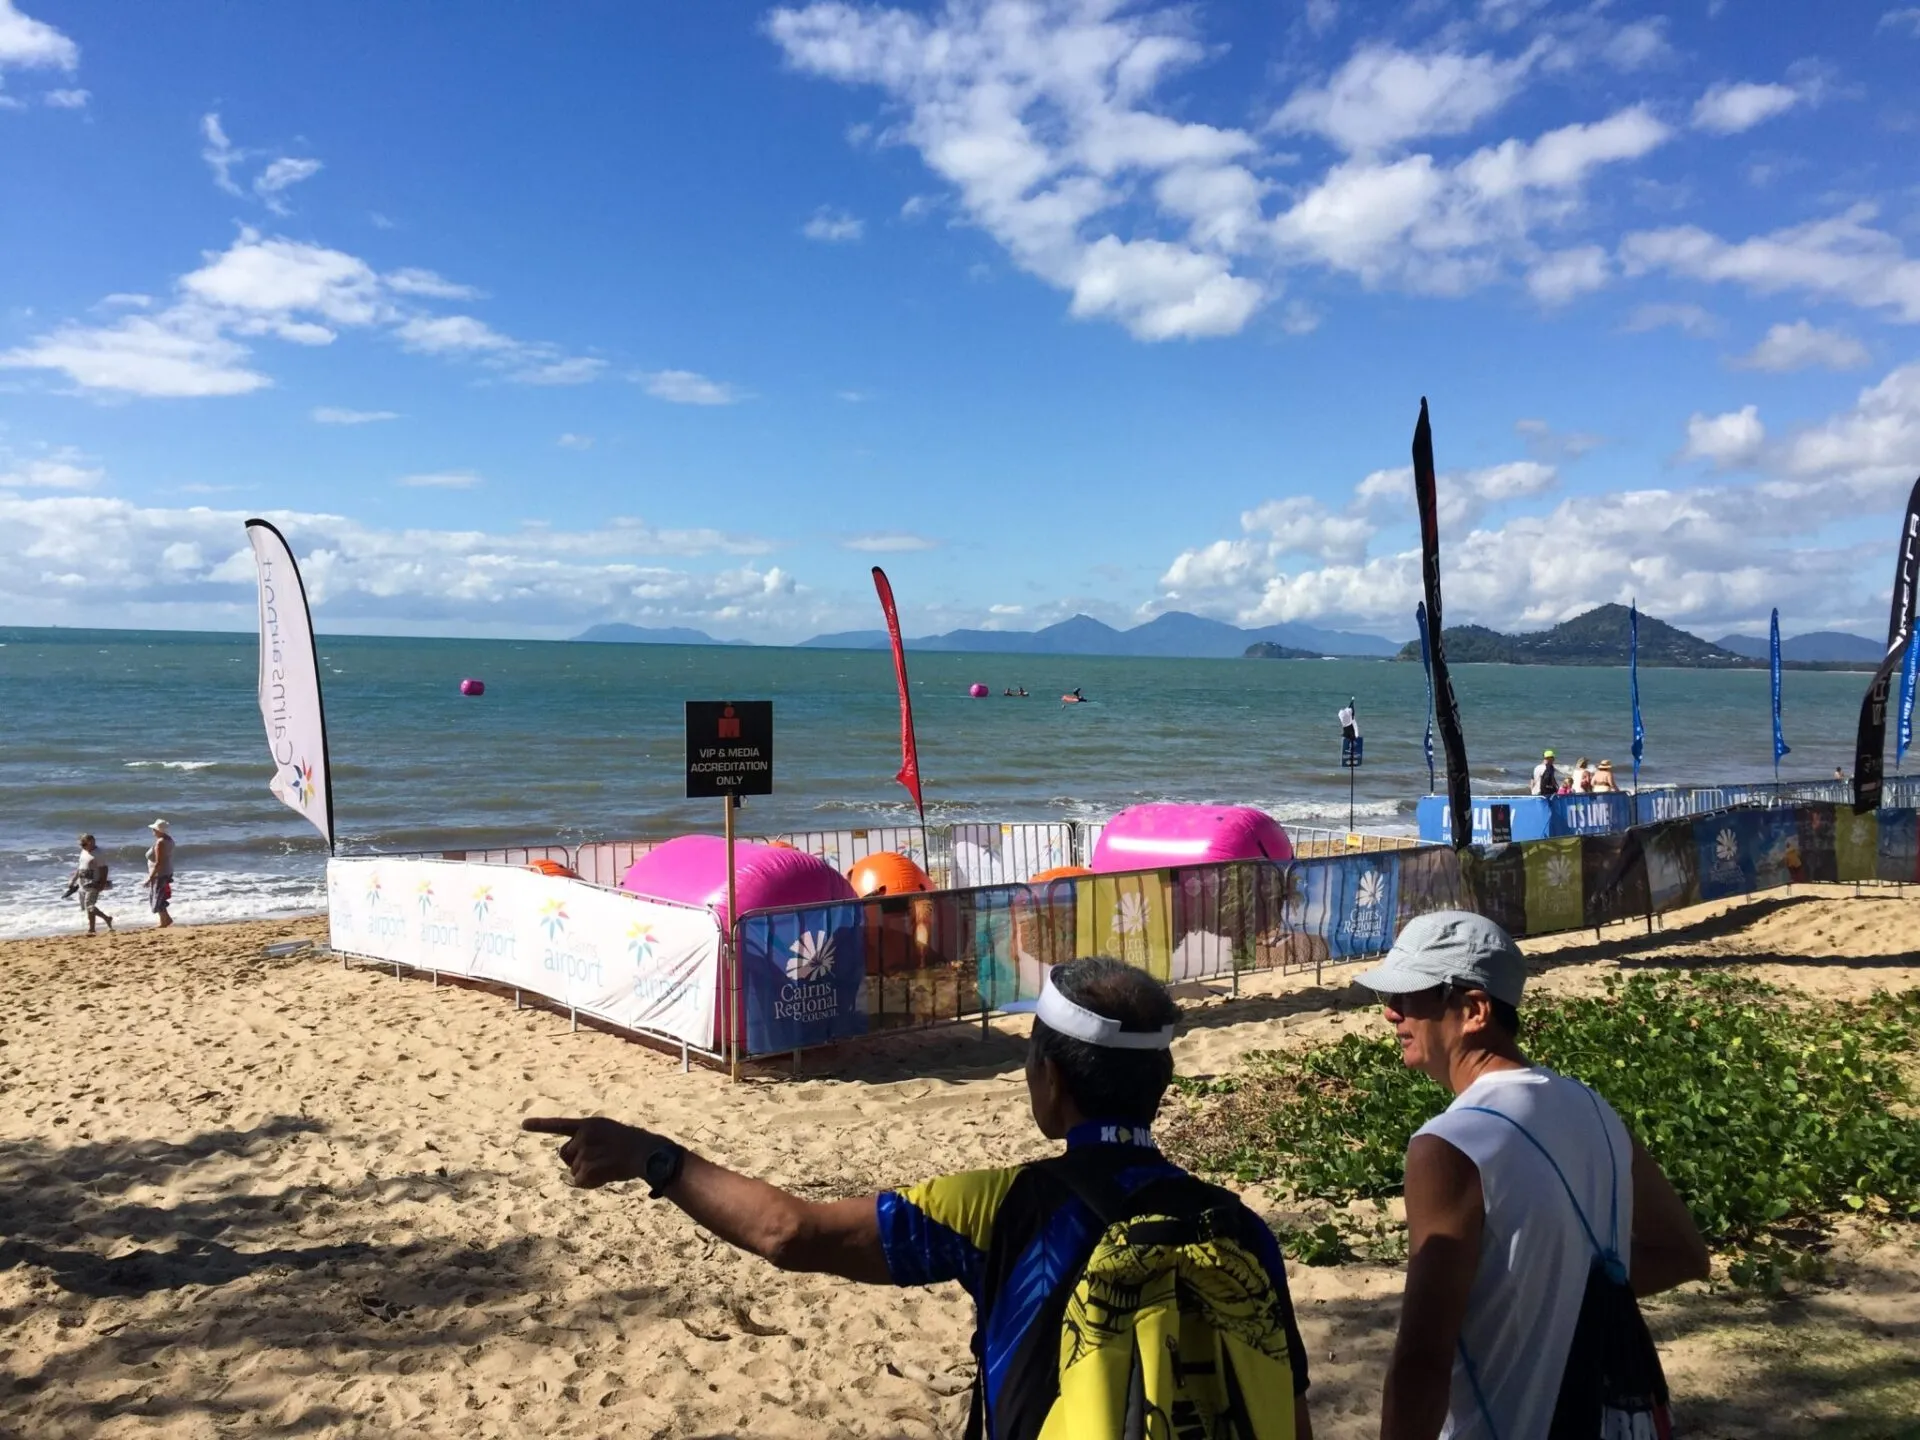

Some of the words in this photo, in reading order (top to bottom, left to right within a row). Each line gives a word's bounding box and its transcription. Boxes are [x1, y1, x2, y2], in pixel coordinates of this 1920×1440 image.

[699, 748, 716, 758] VIP
[718, 748, 726, 757] &
[728, 747, 760, 757] MEDIA
[690, 761, 768, 772] ACCREDITATION
[716, 776, 743, 785] ONLY
[544, 941, 604, 987] airport
[781, 981, 831, 1003] Cairns
[774, 988, 838, 1021] Regional
[802, 1007, 837, 1023] COUNCIL
